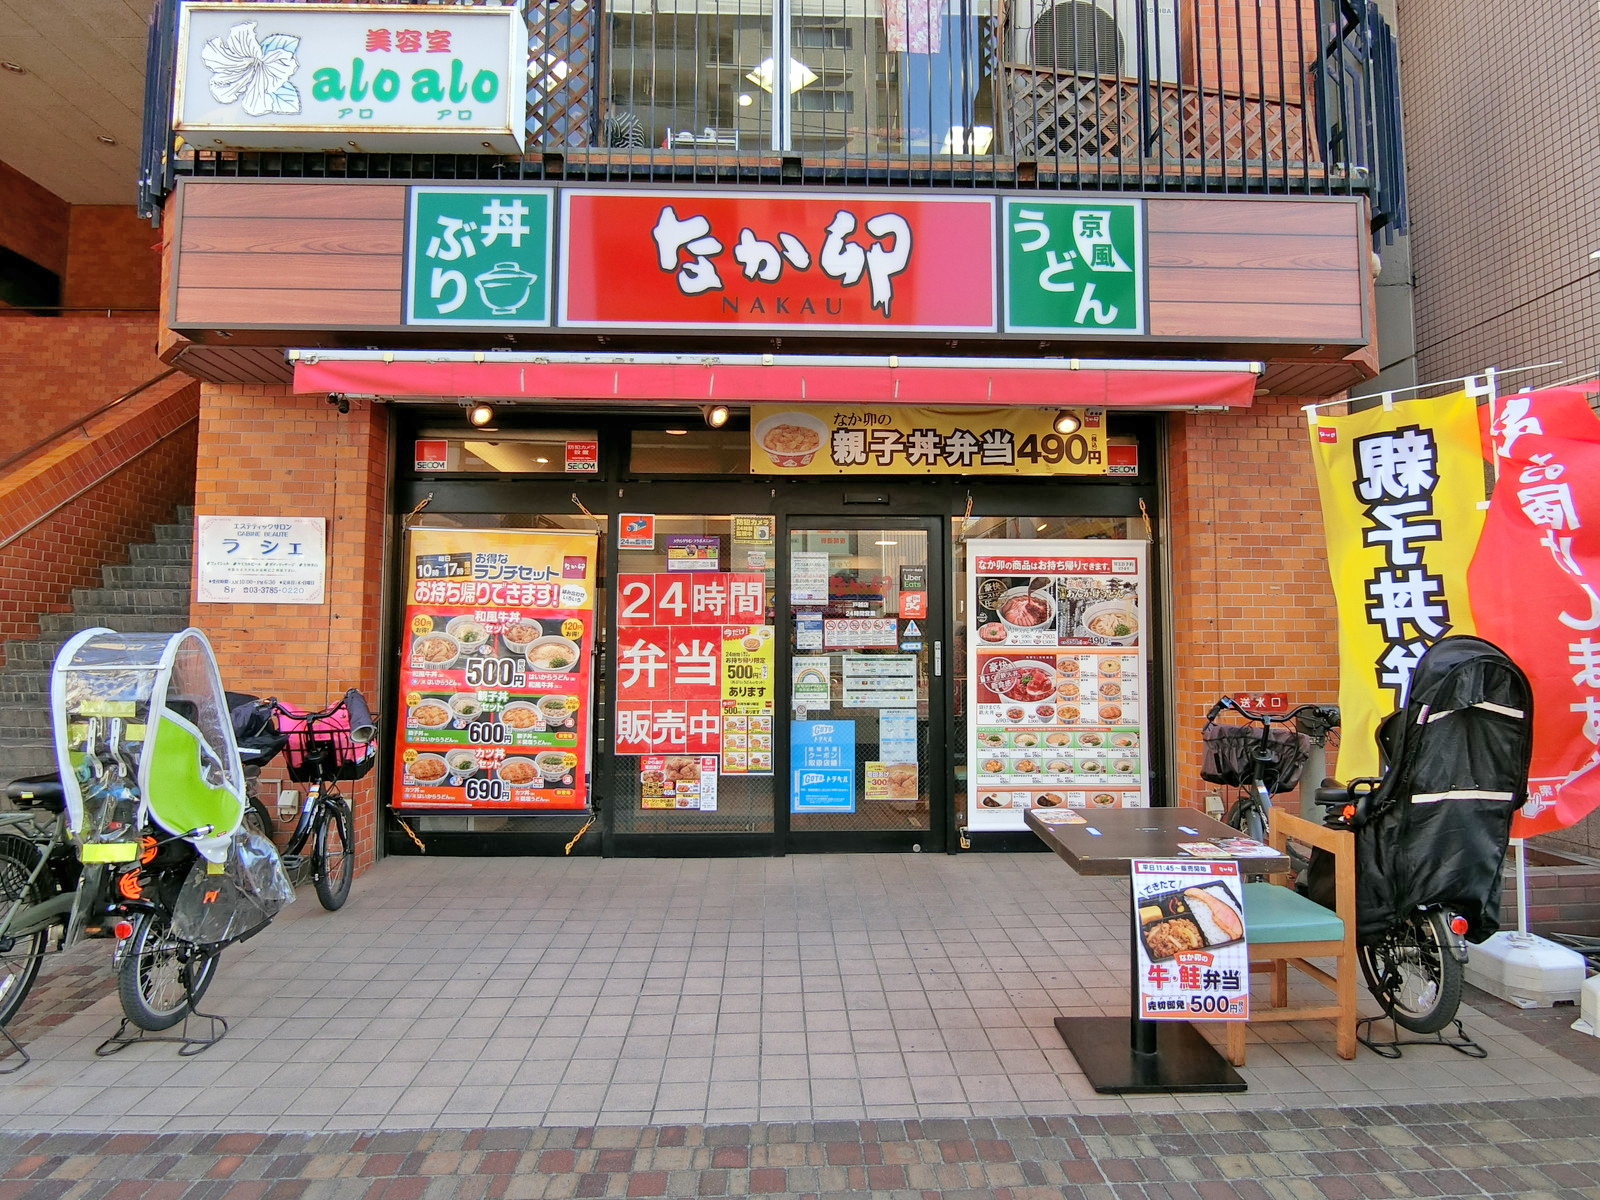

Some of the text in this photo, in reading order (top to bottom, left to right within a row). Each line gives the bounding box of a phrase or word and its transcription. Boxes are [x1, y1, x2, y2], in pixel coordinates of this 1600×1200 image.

[365, 29, 452, 53] 美容室
[312, 57, 499, 103] alo alo
[338, 107, 472, 121] アロ アロ
[1079, 214, 1118, 270] 京風
[652, 205, 913, 319] なか卵
[1012, 208, 1120, 325] うどん
[722, 297, 843, 316] NAKAU
[833, 412, 892, 427] なか卵の
[831, 427, 1102, 467] 親子丼弁当 490円
[234, 523, 292, 531] エステティックサロン
[736, 518, 769, 526] 防犯カメラ
[476, 553, 508, 563] お得な
[565, 563, 586, 571] なか卵
[978, 559, 1111, 572] なか卵の商品はお持ち帰りできます。
[475, 564, 560, 581] ランチセット
[621, 581, 763, 618] 24時間
[414, 617, 432, 627] 80円
[475, 610, 521, 622] 和風牛丼
[485, 623, 509, 633] セット
[564, 622, 582, 631] 120円
[619, 638, 717, 689] 弁当
[466, 658, 524, 687] 500円
[477, 690, 509, 702] 親子丼
[728, 686, 766, 697] あります
[481, 703, 504, 712] セット
[1240, 696, 1281, 708] 送水口
[617, 708, 720, 745] 販売中
[469, 723, 512, 744] 600円
[476, 747, 506, 759] カツ丼
[479, 760, 501, 768] セット
[467, 779, 509, 801] 690円
[1179, 953, 1209, 962] なか卵の
[1148, 1000, 1185, 1011] 売切御免
